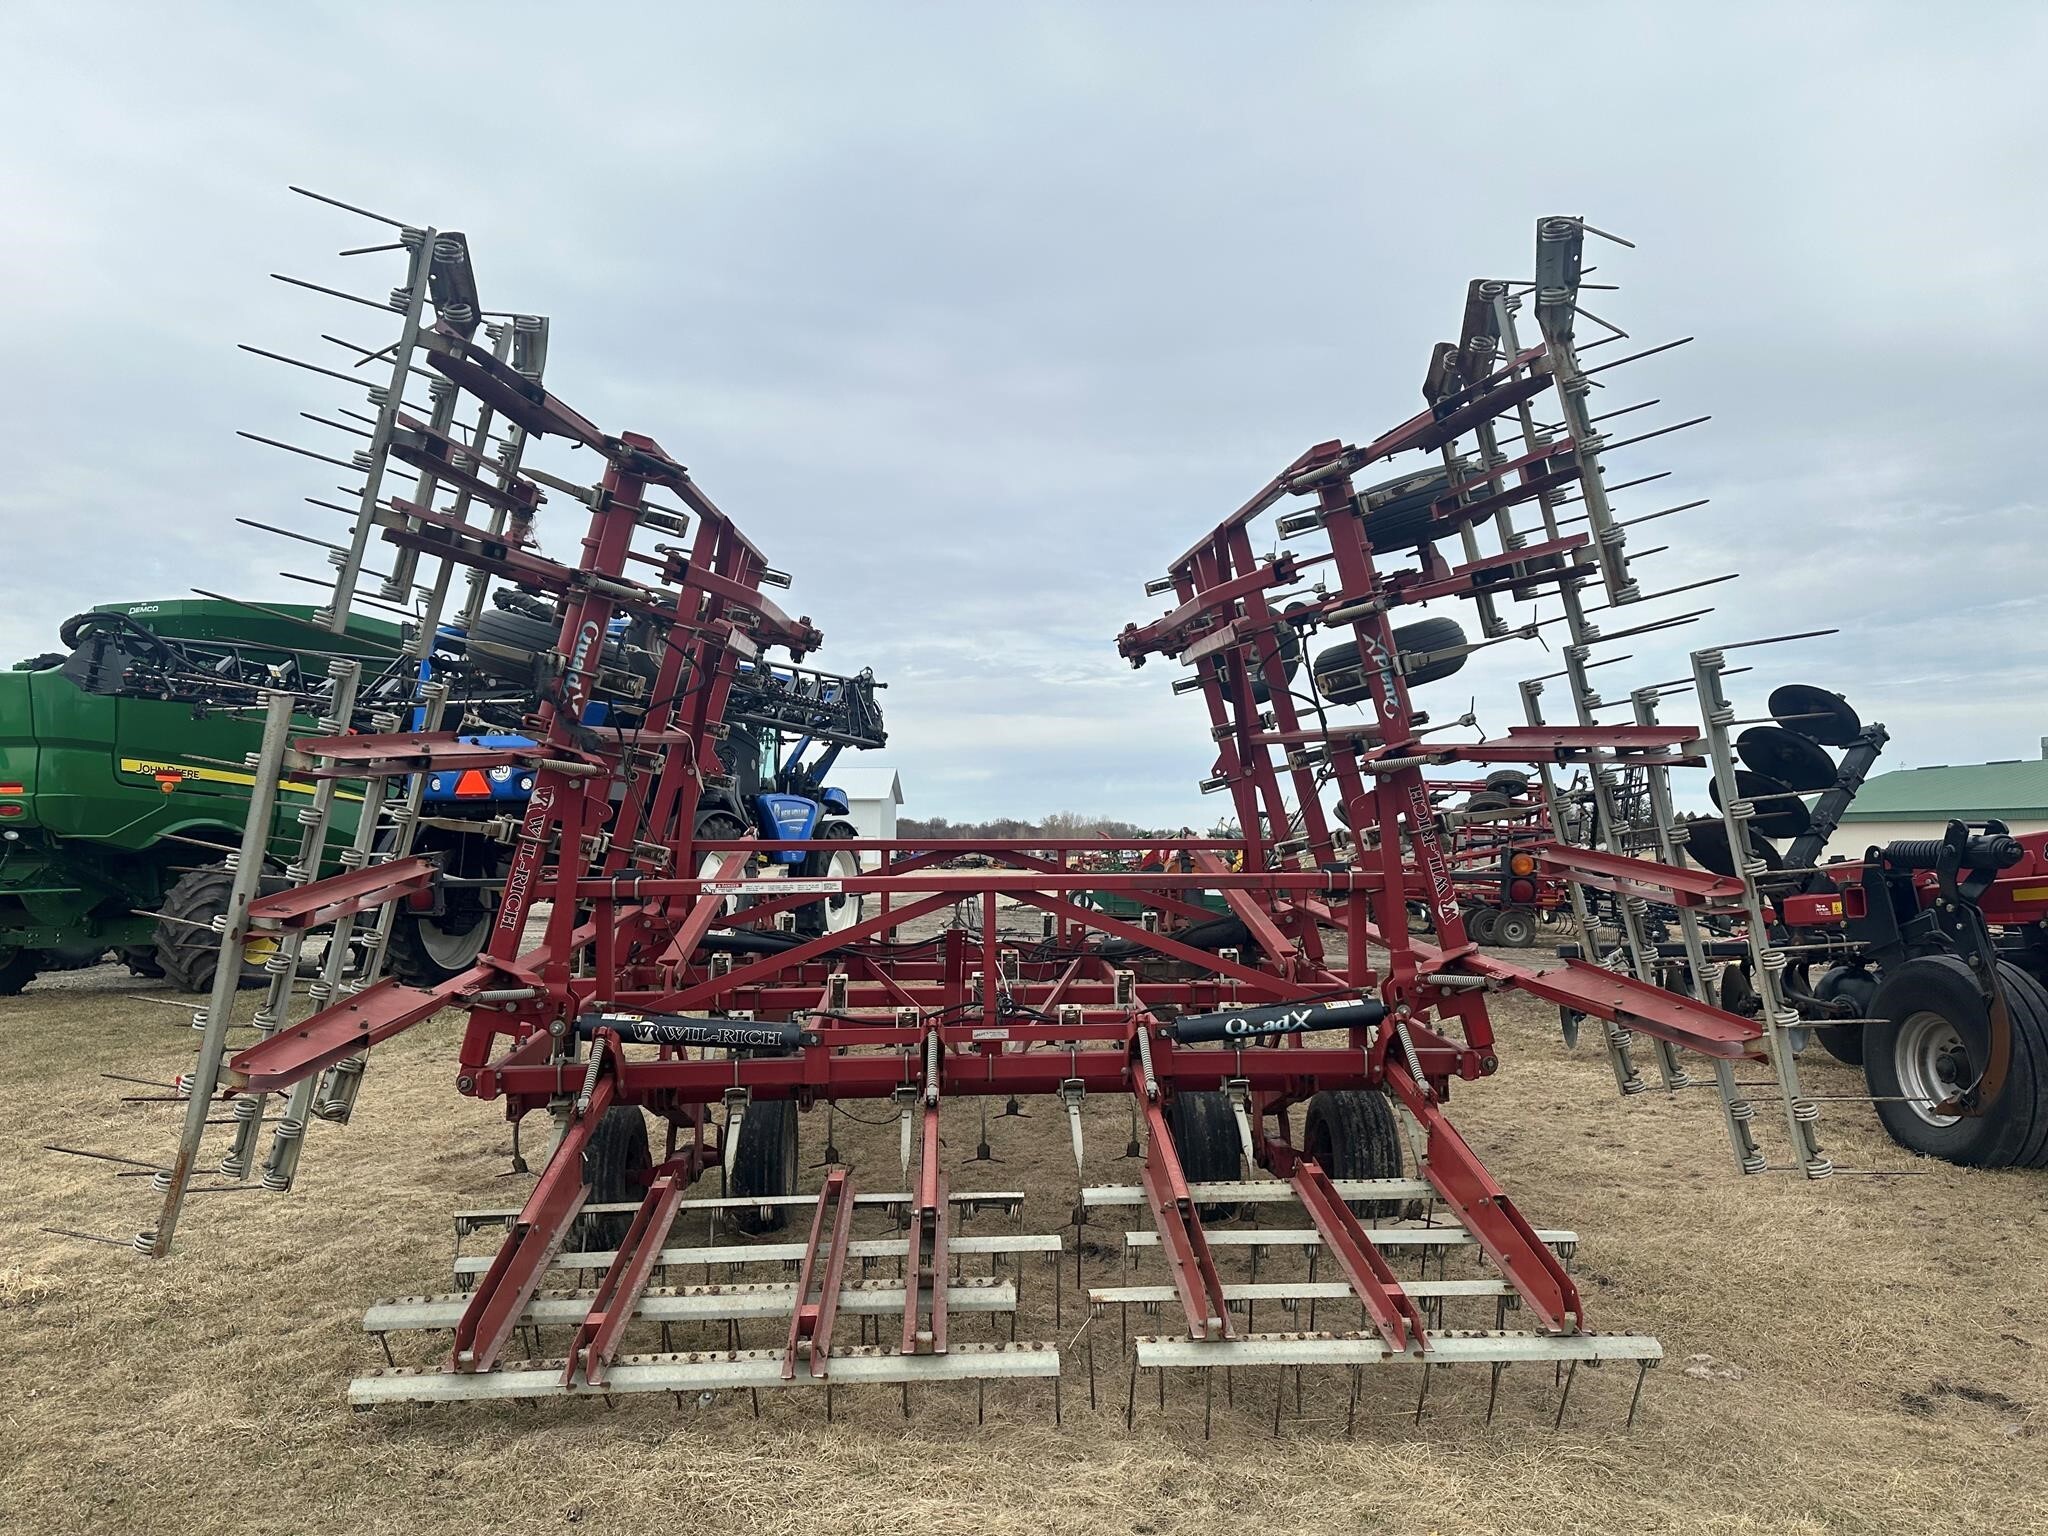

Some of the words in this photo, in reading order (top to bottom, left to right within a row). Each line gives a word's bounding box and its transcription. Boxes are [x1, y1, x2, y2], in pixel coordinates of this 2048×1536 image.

[129, 605, 159, 614] DEMCO
[1362, 633, 1400, 719] QuadX
[167, 766, 200, 778] DERE
[1408, 784, 1449, 897] WIL-RICH
[500, 814, 546, 931] WIL-RICH
[1225, 1008, 1313, 1035] QuadX
[662, 1025, 782, 1046] WIL-RICH
